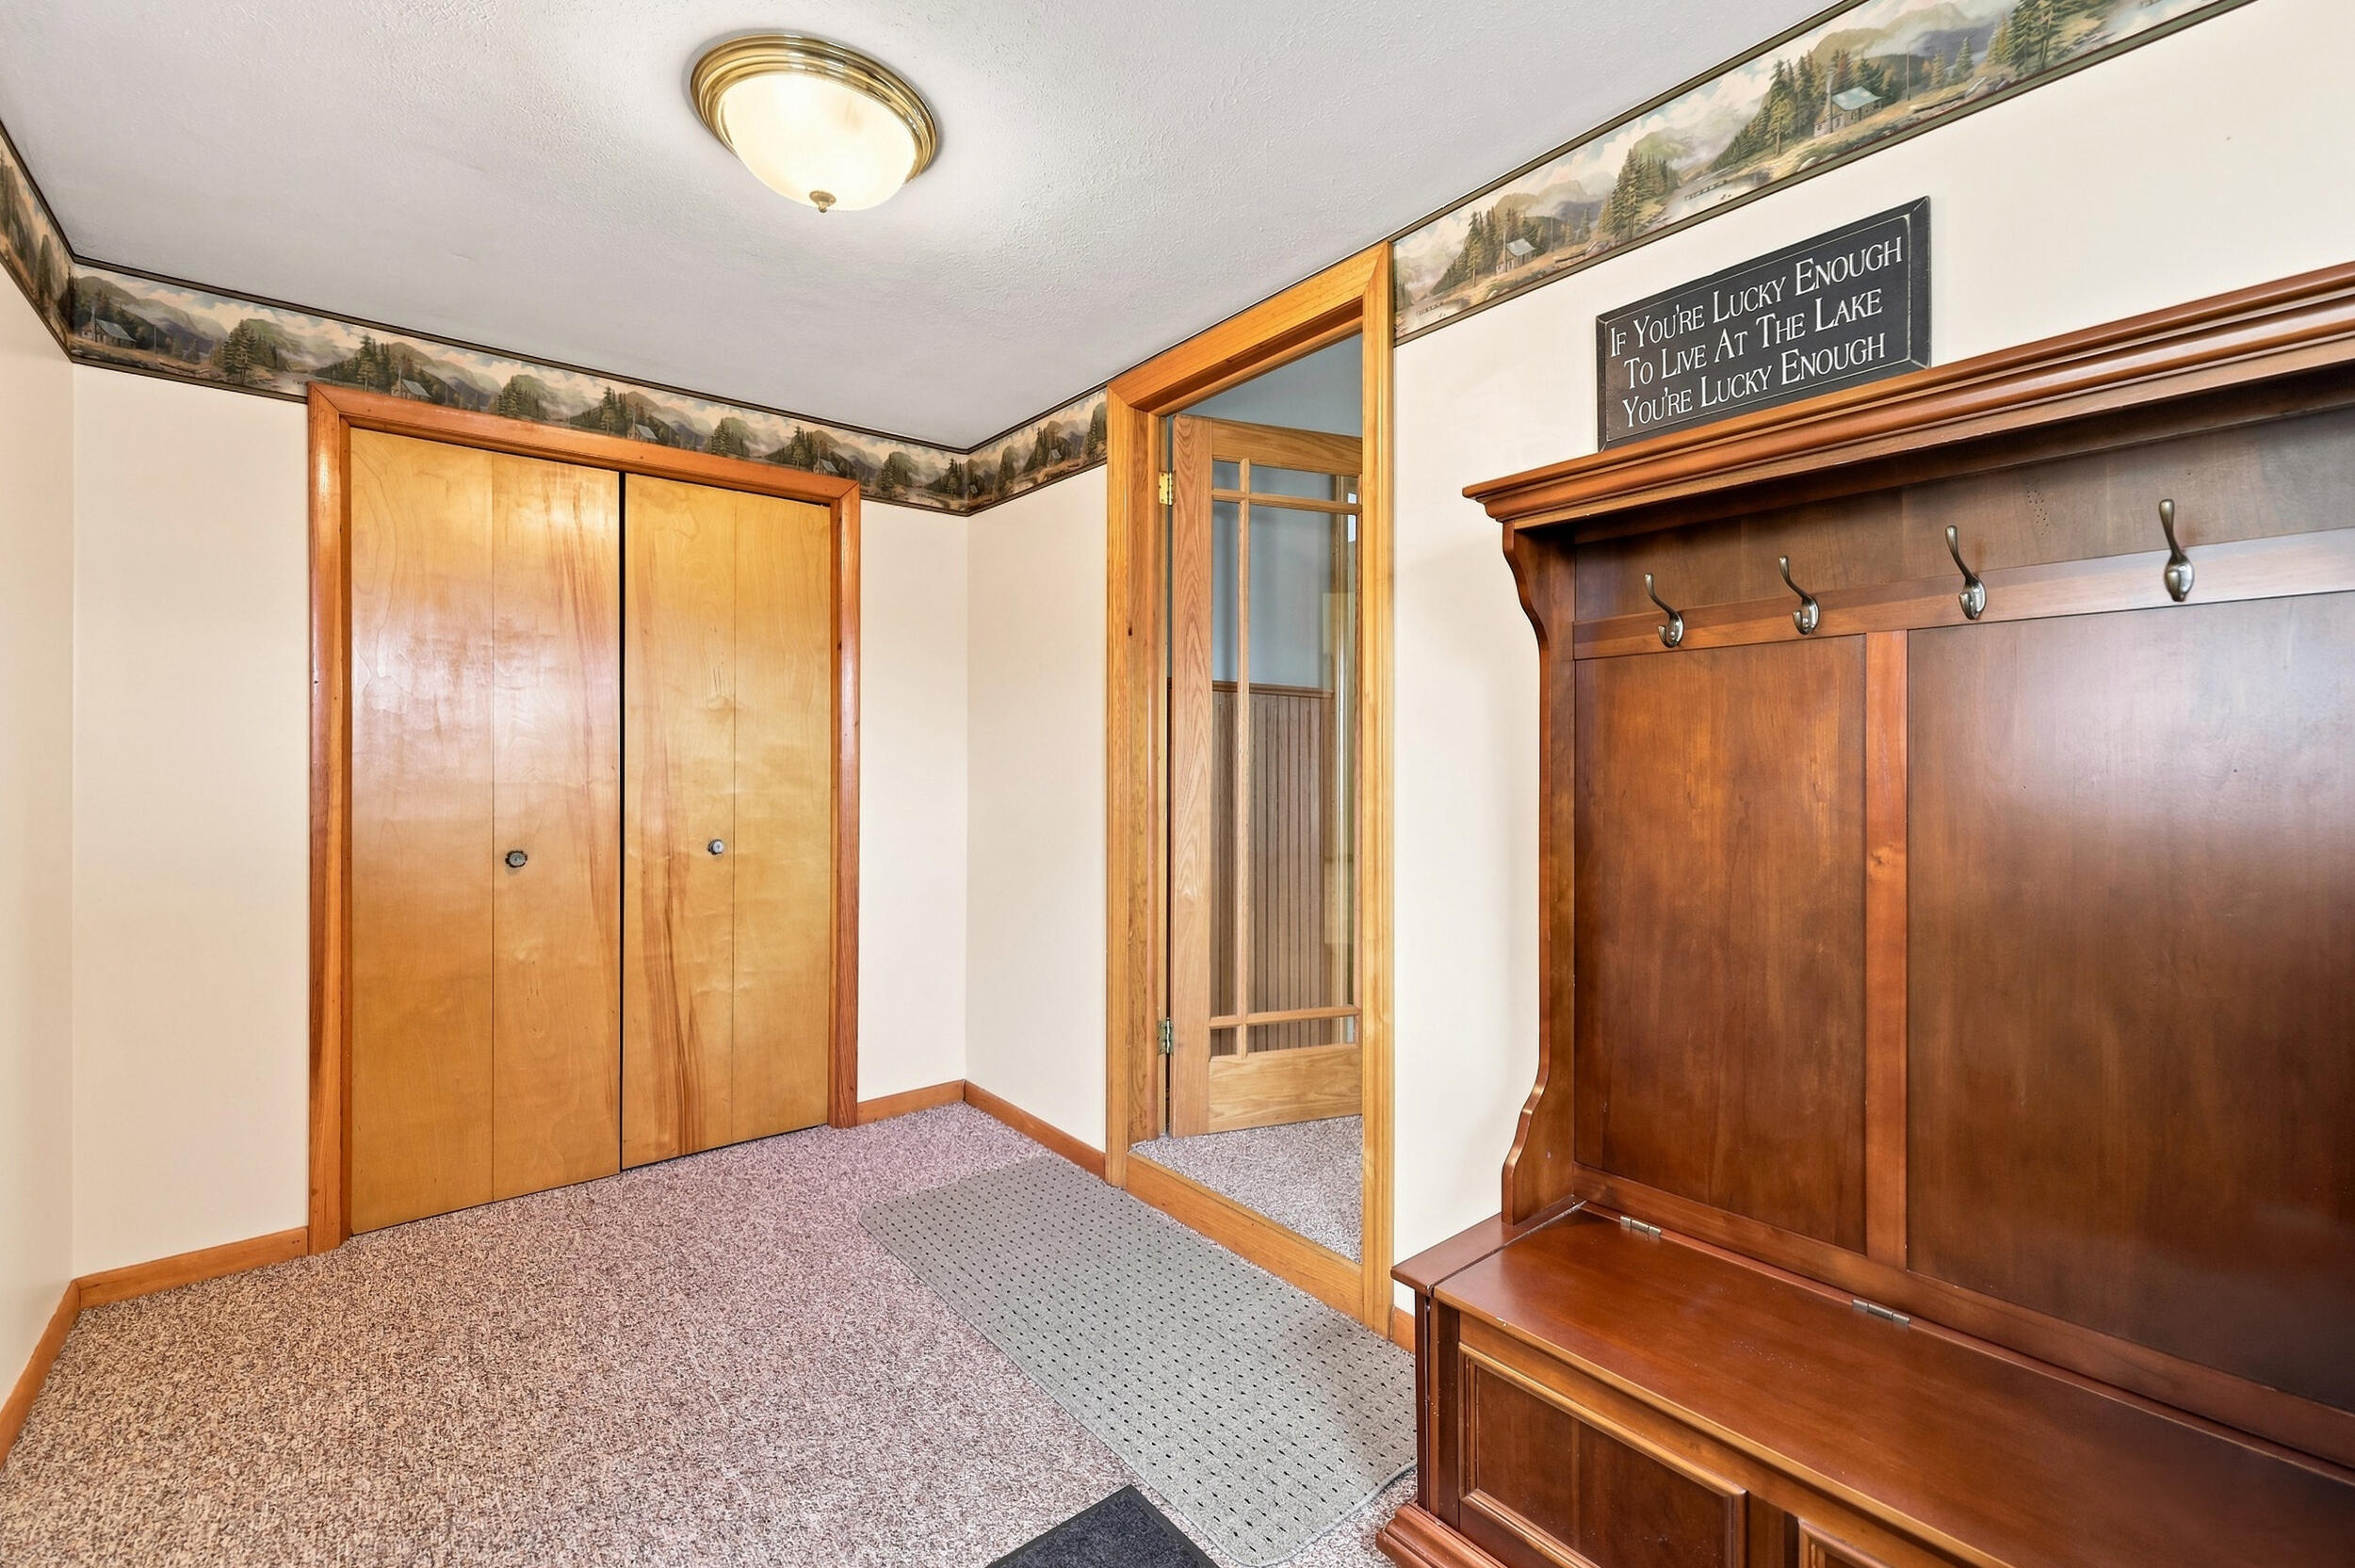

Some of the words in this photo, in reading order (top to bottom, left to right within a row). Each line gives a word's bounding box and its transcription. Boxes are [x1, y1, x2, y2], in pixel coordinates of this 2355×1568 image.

[1610, 327, 1627, 357] IF
[1633, 304, 1705, 348] YOU'RE
[1713, 277, 1786, 323] LUCKY
[1795, 237, 1902, 295] ENOUGH
[1624, 358, 1653, 389] TO
[1661, 345, 1707, 379] LIVE
[1714, 328, 1748, 363] AT
[1756, 313, 1805, 348] THE
[1814, 288, 1883, 332] LAKE
[1622, 387, 1693, 428] YOU'RE
[1700, 365, 1772, 407] LUCKY
[1781, 332, 1885, 384] ENOUGH
